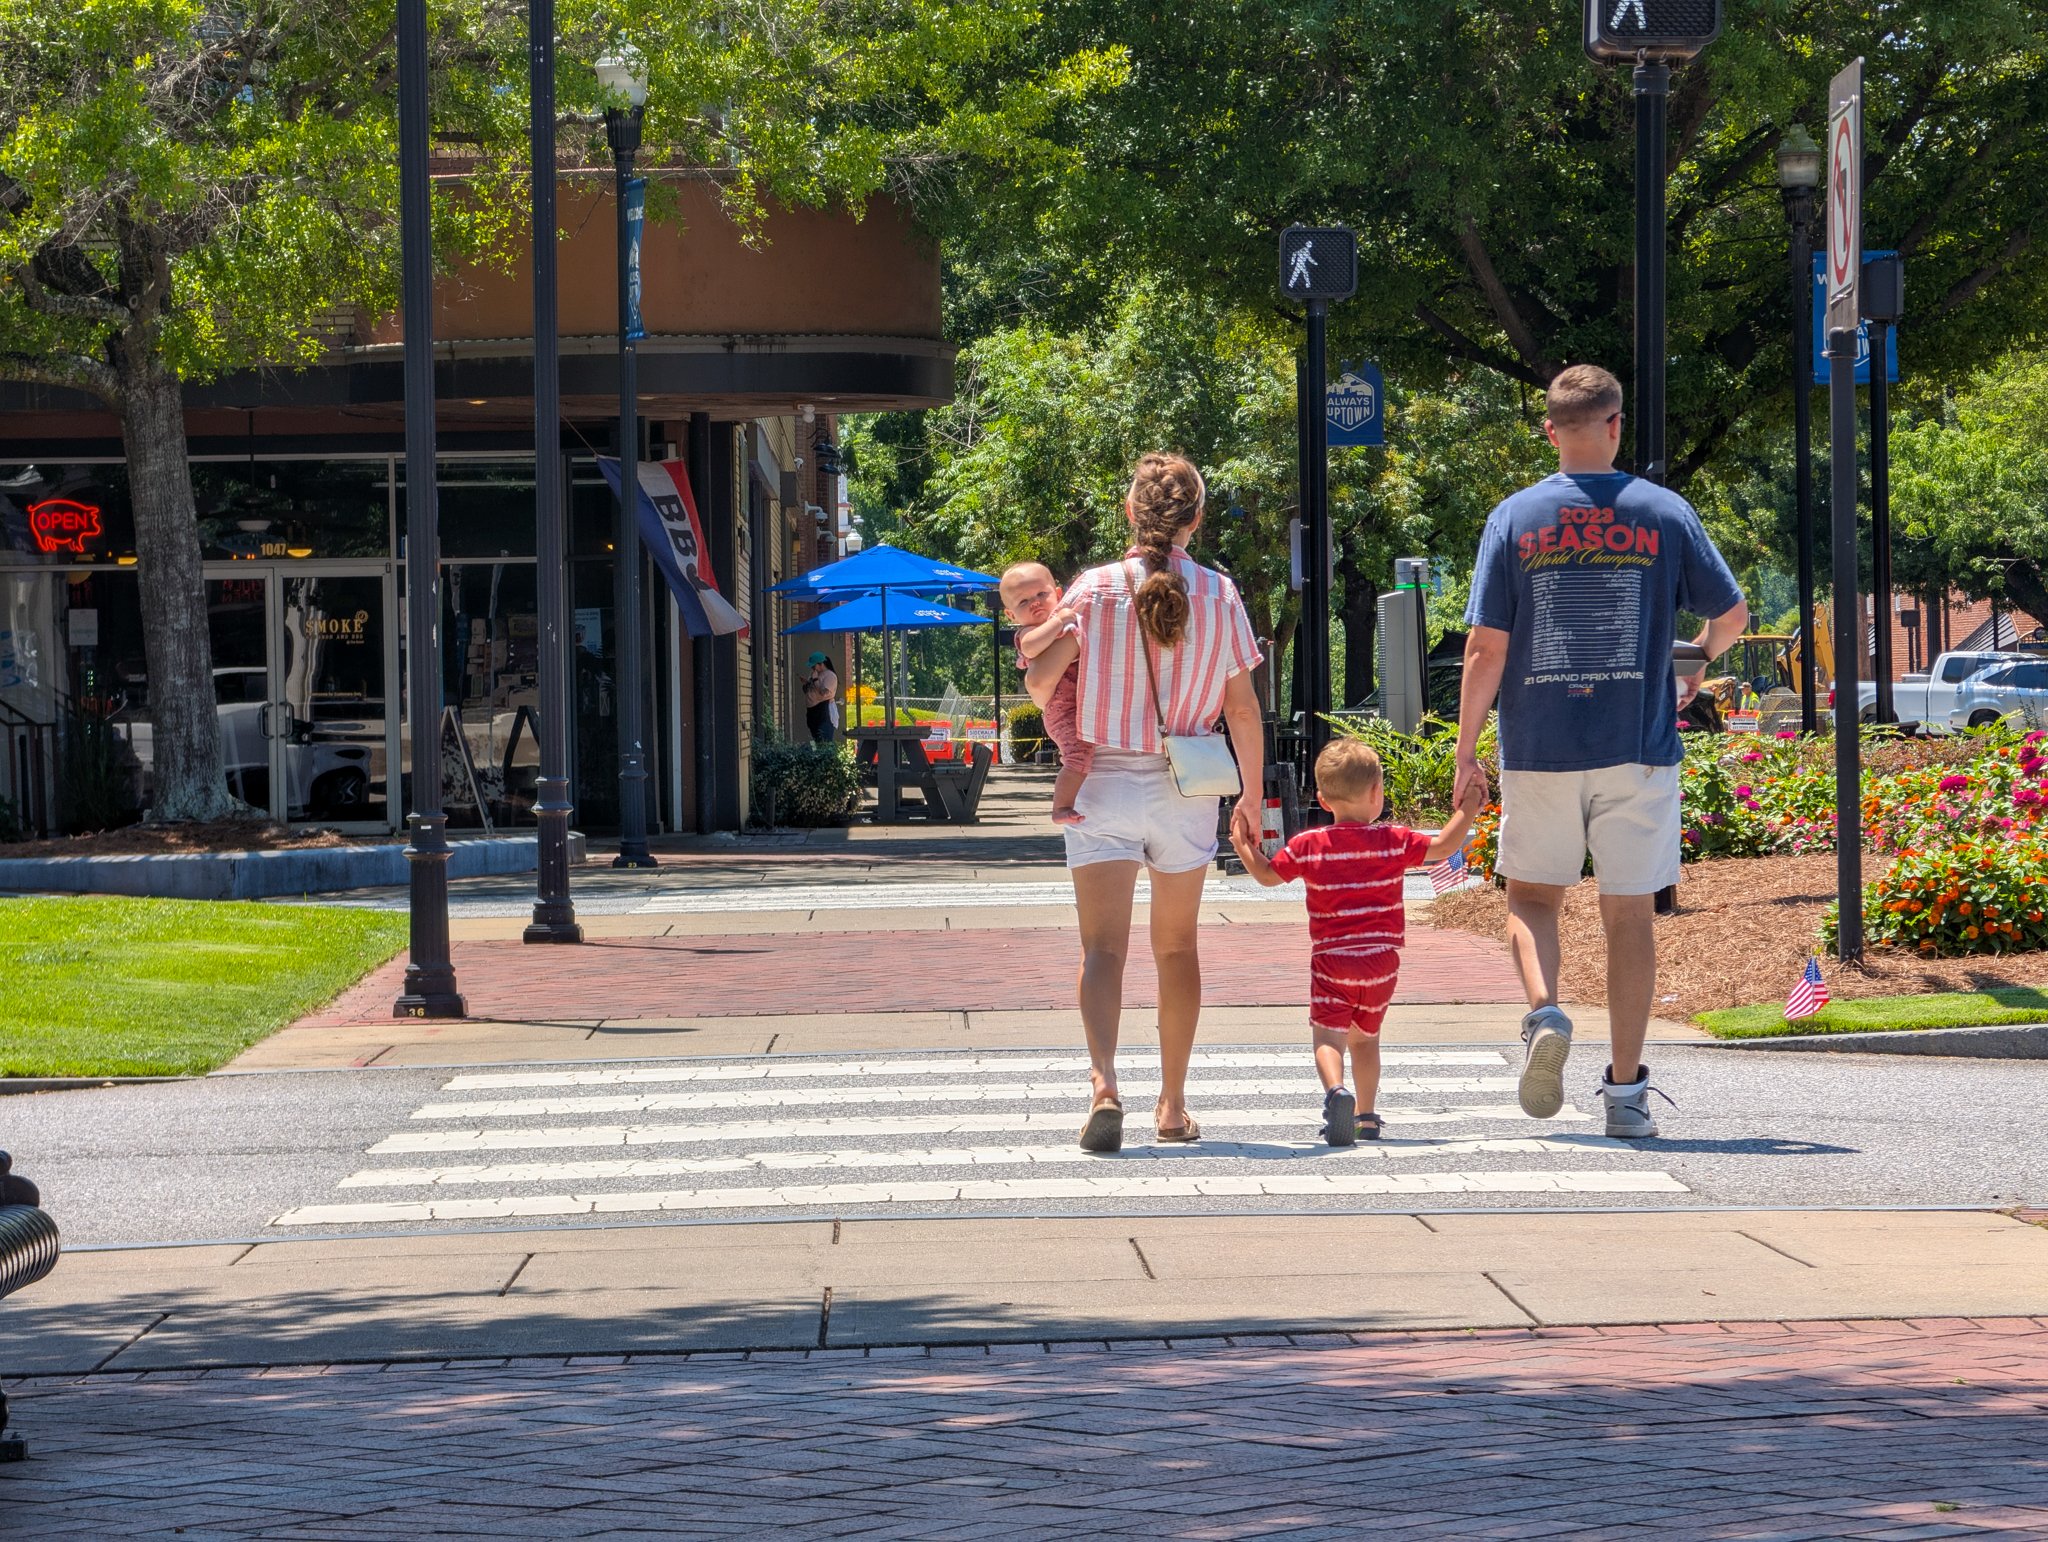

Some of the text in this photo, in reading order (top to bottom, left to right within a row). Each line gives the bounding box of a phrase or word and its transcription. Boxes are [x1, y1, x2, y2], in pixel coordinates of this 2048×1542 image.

[1327, 407, 1370, 425] UPTOWN
[37, 512, 87, 530] OPEN
[1559, 507, 1614, 524] 2023
[260, 543, 287, 556] 1047
[1518, 525, 1659, 558] SEASON
[1520, 545, 1658, 573] World Champions
[305, 618, 363, 634] SMOKE
[1524, 671, 1644, 685] 21 GRAND PRIX WINS
[409, 1007, 425, 1017] 36
